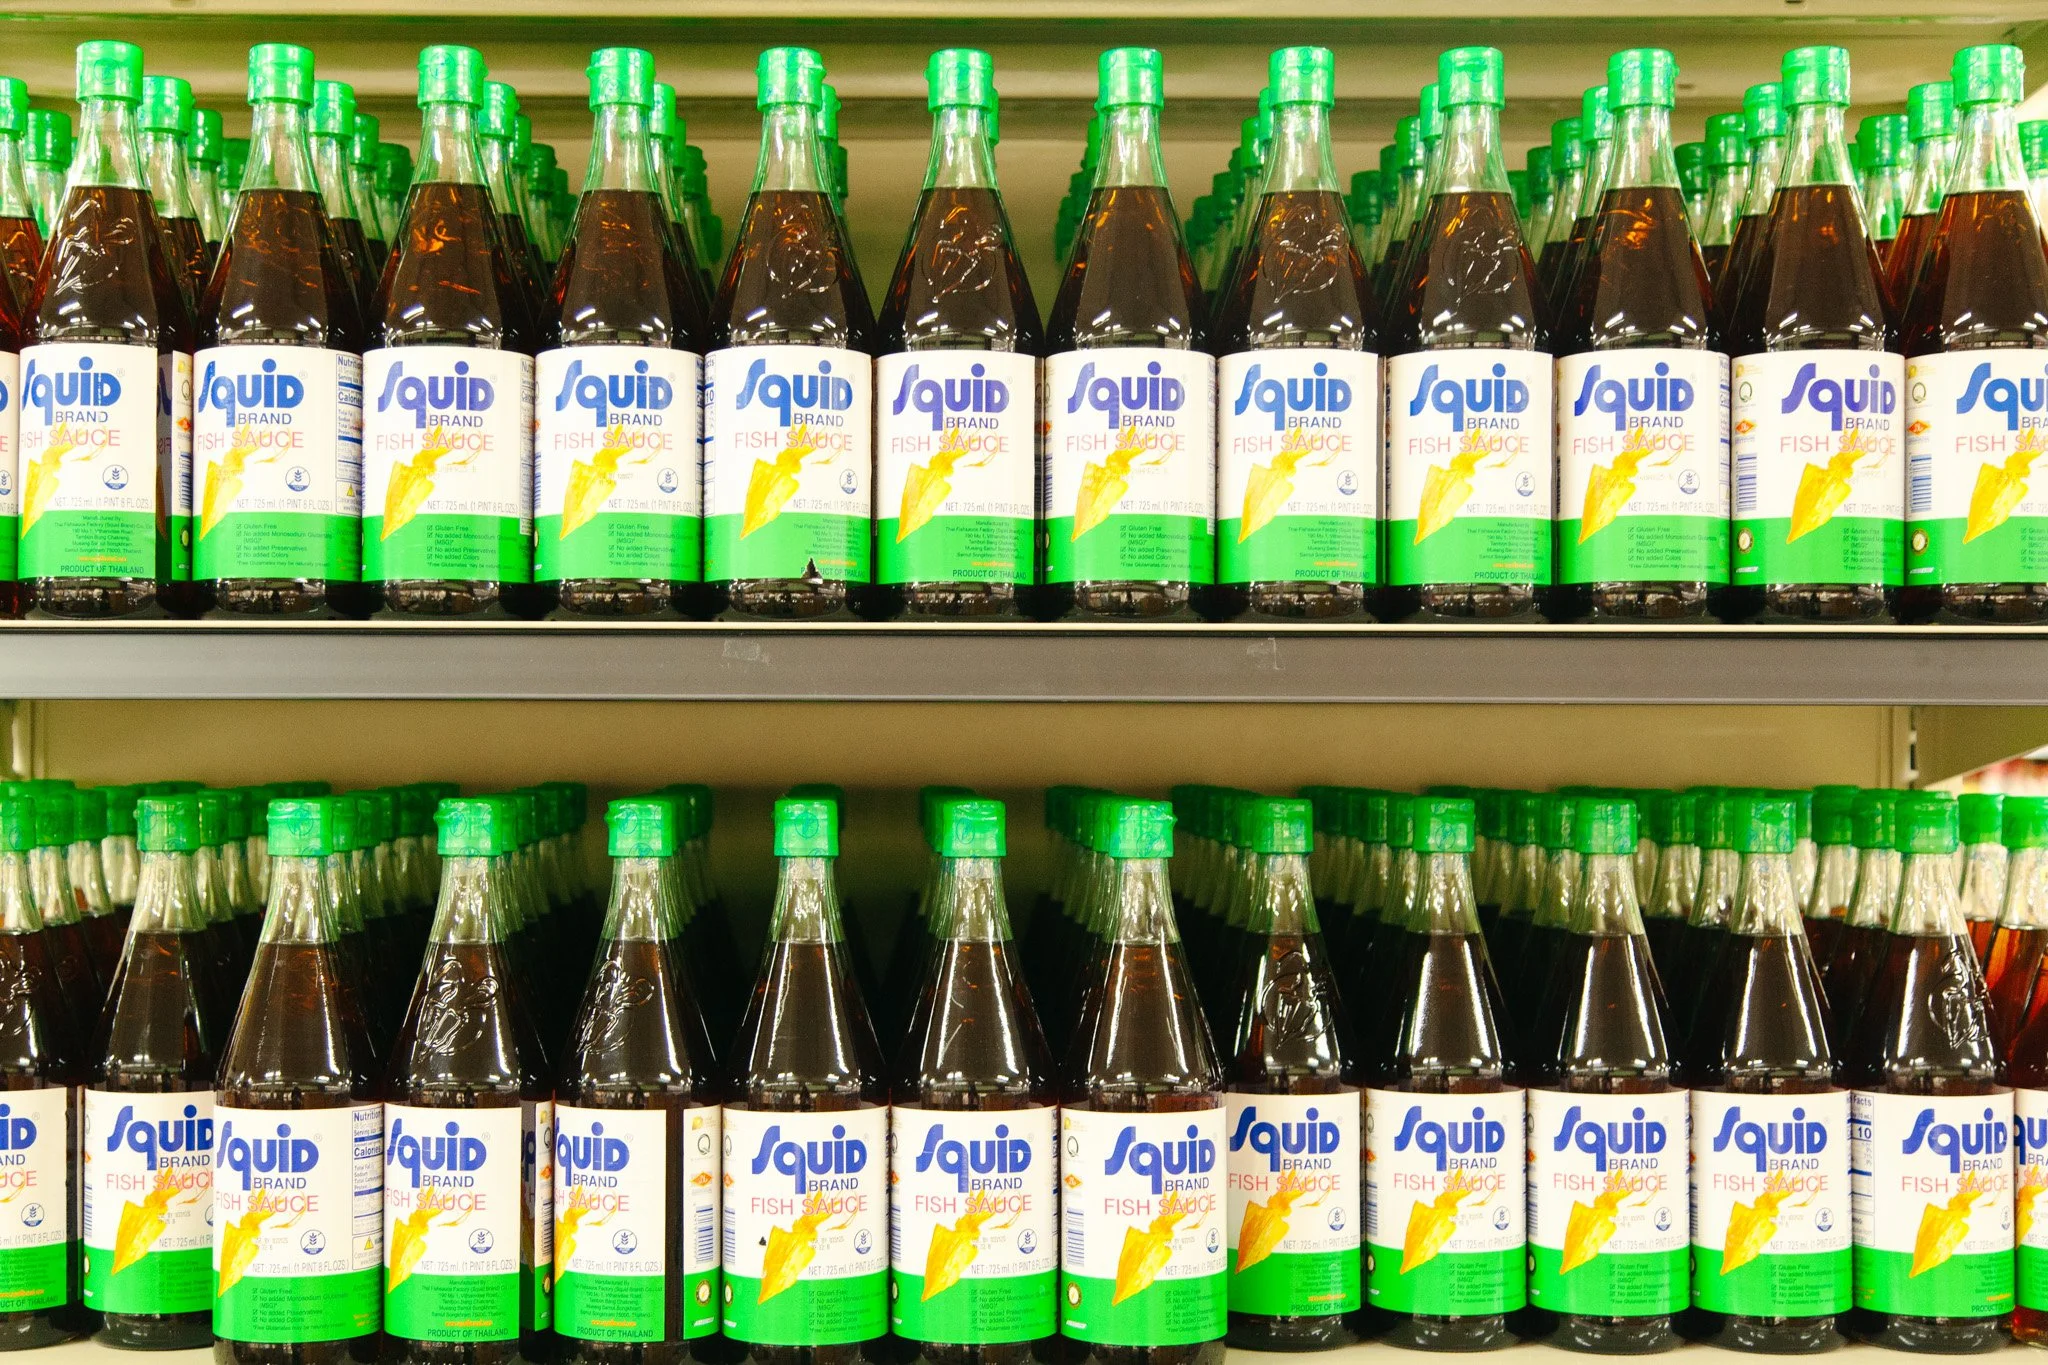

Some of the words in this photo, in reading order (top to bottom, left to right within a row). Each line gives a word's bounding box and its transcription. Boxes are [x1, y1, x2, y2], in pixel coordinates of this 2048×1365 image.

[55, 411, 108, 423] BRAND
[238, 414, 292, 425] BRAND
[430, 415, 484, 426] BRAND
[610, 414, 662, 426] BRAND
[794, 414, 844, 426] BRAND
[946, 416, 999, 429] BRAND
[1122, 416, 1175, 428] BRAND
[1289, 416, 1342, 428] BRAND
[1467, 417, 1520, 430] BRAND
[1629, 416, 1683, 428] BRAND
[1846, 417, 1890, 430] BRAND
[50, 430, 120, 446] SAUCE
[198, 434, 228, 450] FISH
[231, 432, 304, 449] SAUCE
[376, 435, 414, 451] FISH
[422, 434, 494, 451] SAUCE
[554, 434, 594, 450] FISH
[603, 433, 673, 450] SAUCE
[735, 432, 778, 450] FISH
[786, 433, 852, 450] SAUCE
[892, 437, 930, 454] FISH
[940, 435, 1010, 453] SAUCE
[1066, 435, 1106, 452] FISH
[1115, 434, 1185, 452] SAUCE
[1234, 436, 1272, 454] FISH
[1281, 435, 1352, 452] SAUCE
[1573, 436, 1614, 454] FISH
[1622, 434, 1694, 452] SAUCE
[1956, 435, 2005, 452] FISH
[1410, 437, 1450, 454] FISH
[1459, 436, 1529, 453] SAUCE
[1780, 436, 1830, 452] FISH
[1838, 436, 1896, 455] SAUCE
[446, 501, 457, 510] 725
[477, 502, 491, 511] PINT
[1000, 571, 1026, 579] THAILAND
[1858, 1128, 1872, 1139] 10
[160, 1155, 210, 1168] BRAND
[1284, 1158, 1332, 1170] BRAND
[1449, 1157, 1498, 1170] BRAND
[1609, 1158, 1658, 1170] BRAND
[1770, 1158, 1818, 1170] BRAND
[1962, 1158, 2002, 1170] BRAND
[106, 1174, 145, 1190] FISH
[254, 1176, 306, 1189] BRAND
[422, 1175, 474, 1188] BRAND
[573, 1174, 618, 1187] BRAND
[809, 1178, 858, 1191] BRAND
[972, 1177, 1022, 1190] BRAND
[1165, 1177, 1210, 1190] BRAND
[1228, 1174, 1268, 1190] FISH
[1276, 1174, 1340, 1192] SAUCE
[1394, 1173, 1435, 1190] FISH
[1443, 1173, 1506, 1191] SAUCE
[1554, 1174, 1595, 1190] FISH
[1604, 1174, 1667, 1191] SAUCE
[1714, 1174, 1755, 1190] FISH
[1764, 1174, 1828, 1192] SAUCE
[1902, 1176, 1948, 1192] FISH
[1956, 1174, 2009, 1192] SAUCE
[248, 1194, 318, 1212] SAUCE
[386, 1188, 410, 1208] FISH
[416, 1194, 486, 1210] SAUCE
[568, 1194, 630, 1212] SAUCE
[915, 1196, 956, 1213] FISH
[966, 1195, 1032, 1214] SAUCE
[1104, 1198, 1150, 1215] FISH
[1158, 1196, 1216, 1214] SAUCE
[752, 1197, 794, 1214] FISH
[804, 1197, 867, 1216] SAUCE
[270, 1264, 281, 1273] 725
[302, 1263, 317, 1272] PINT
[438, 1262, 449, 1271] 725
[470, 1262, 485, 1271] PINT
[475, 1328, 508, 1337] THAILAND
[577, 1327, 604, 1336] PRODUCT
